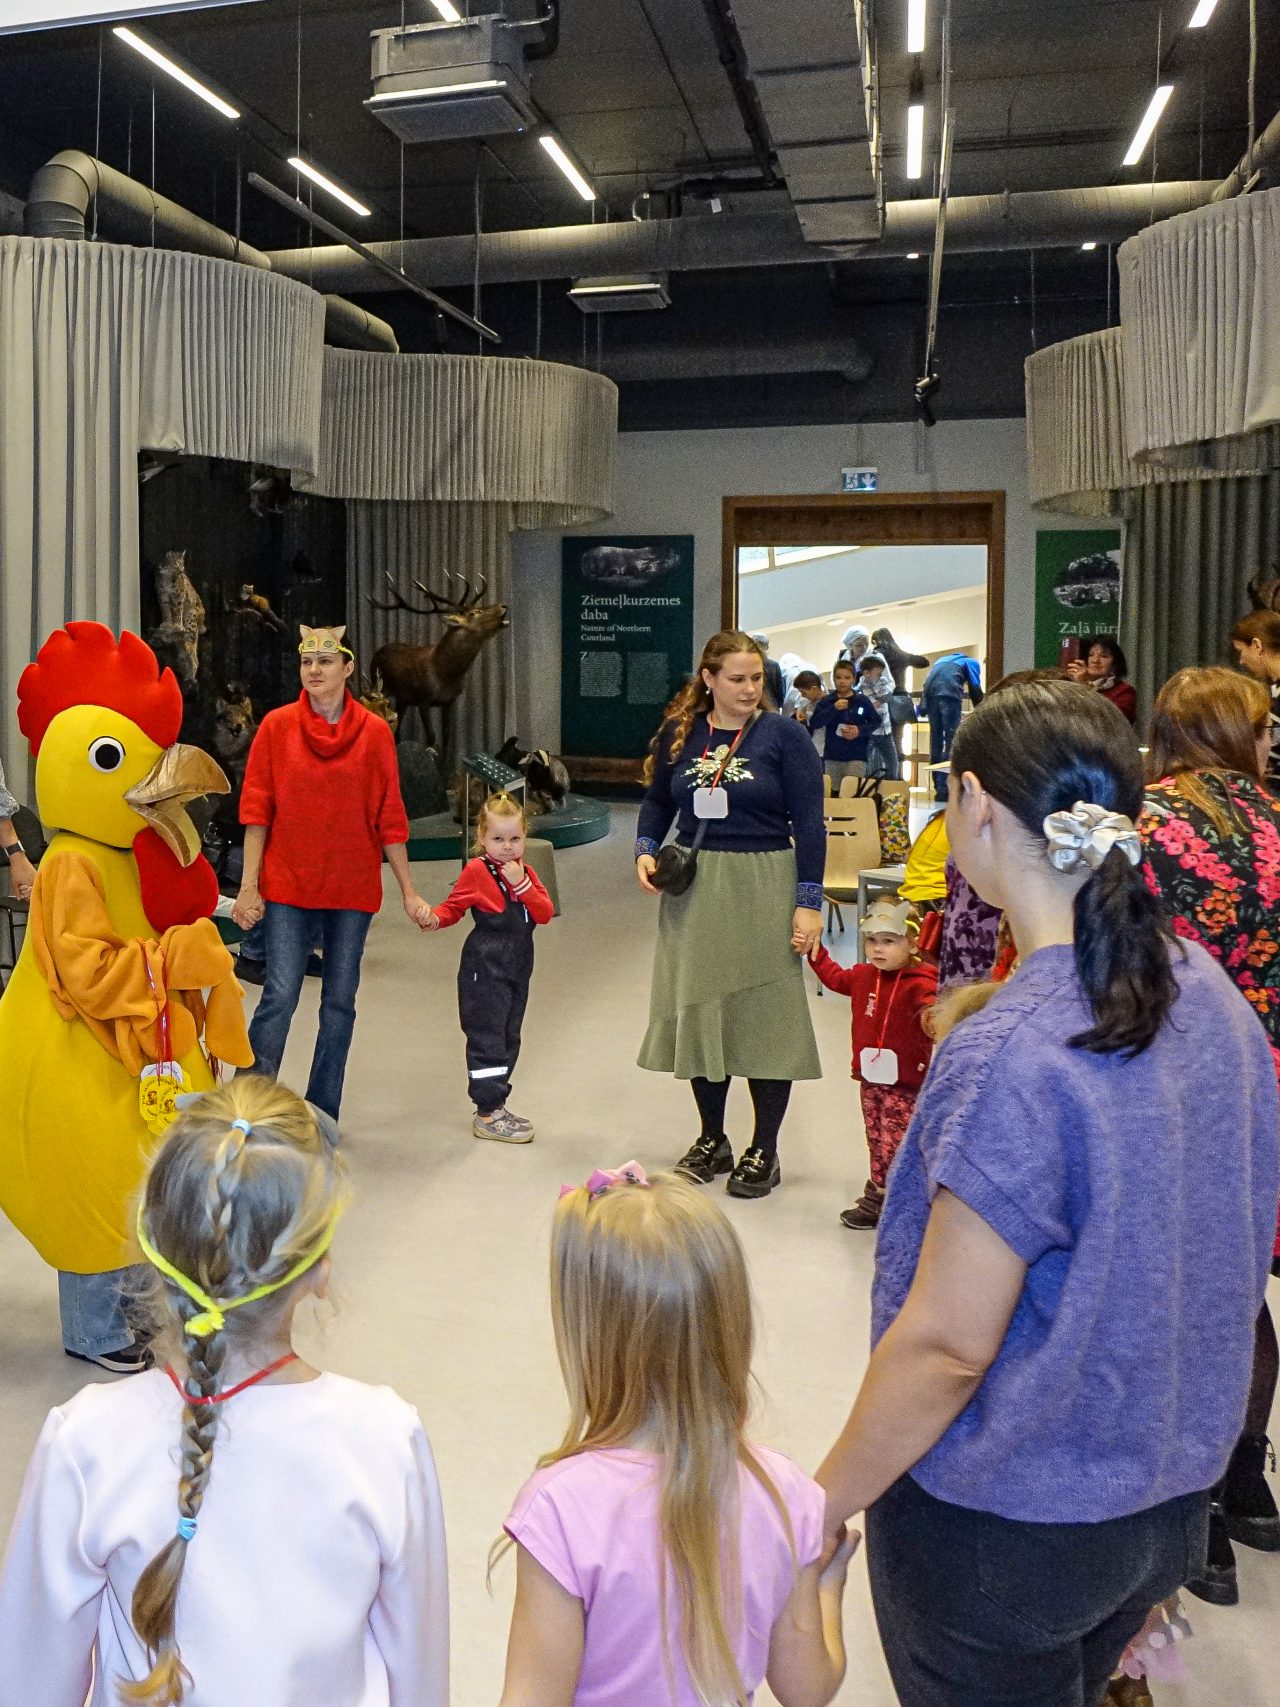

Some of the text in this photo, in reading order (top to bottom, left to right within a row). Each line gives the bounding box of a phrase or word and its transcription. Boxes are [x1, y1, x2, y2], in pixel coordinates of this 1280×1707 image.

[581, 594, 681, 609] Ziemeļkurzemes
[580, 608, 609, 620] daba
[580, 623, 652, 632] Nature of Northern
[1058, 620, 1090, 637] Zaļā
